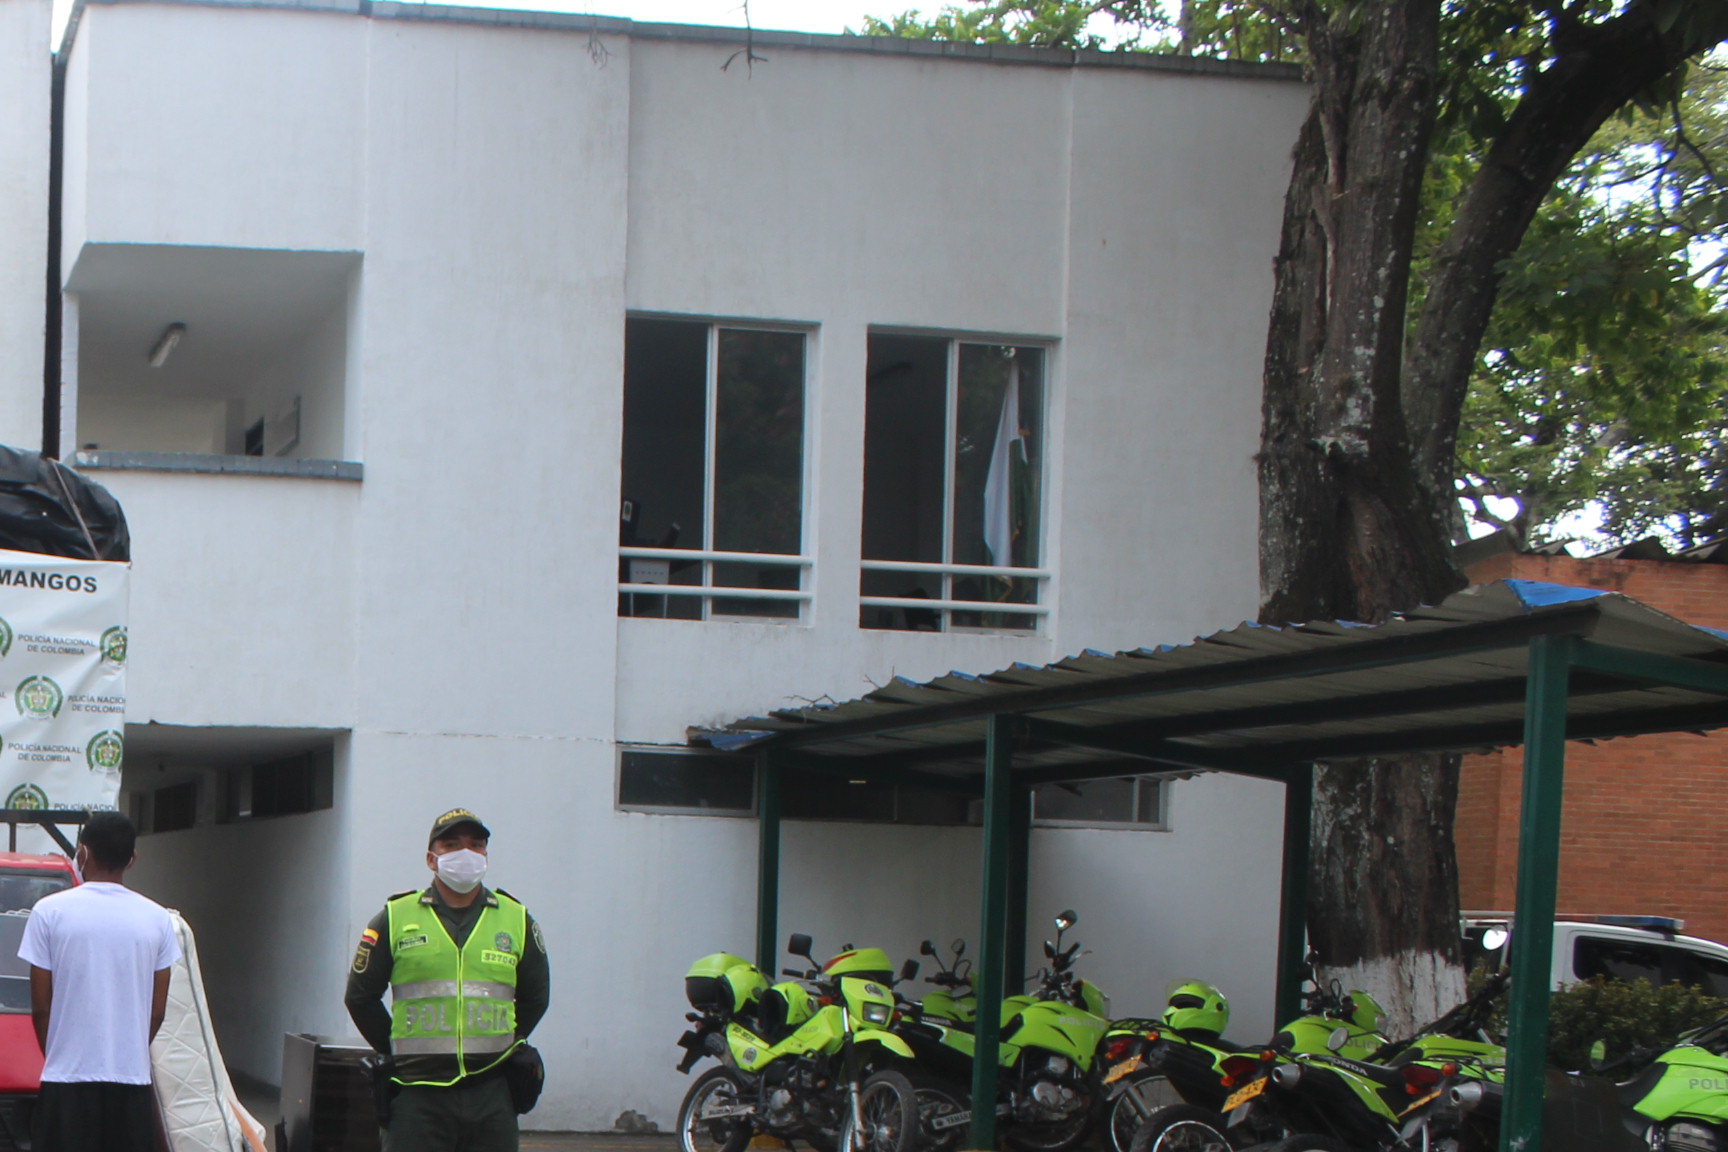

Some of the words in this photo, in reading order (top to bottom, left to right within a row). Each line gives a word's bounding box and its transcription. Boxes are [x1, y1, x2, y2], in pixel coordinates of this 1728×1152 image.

[52, 636, 96, 648] NACIONAL
[26, 644, 40, 653] DE
[40, 646, 85, 656] COLOMBIA
